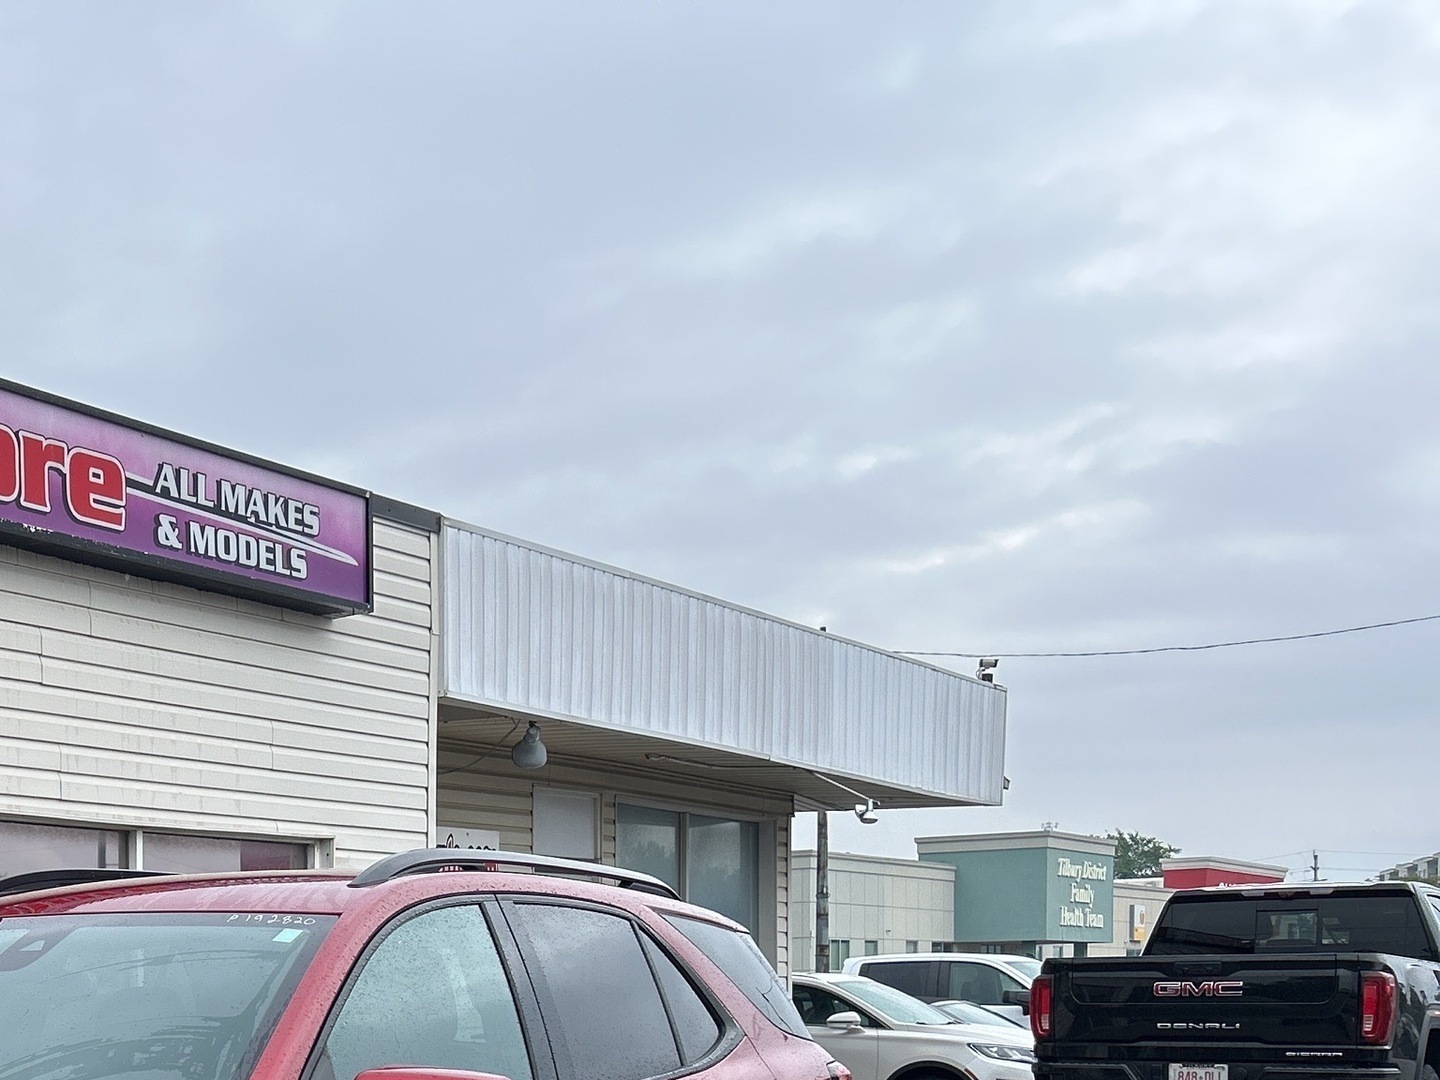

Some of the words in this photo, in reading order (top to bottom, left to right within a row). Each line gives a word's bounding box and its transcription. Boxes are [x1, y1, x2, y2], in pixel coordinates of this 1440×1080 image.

[154, 462, 215, 508] ALL
[219, 479, 320, 537] MAKES
[157, 513, 183, 550] &
[188, 520, 309, 580] MODELS
[1057, 858, 1082, 882] Tilbury
[1081, 861, 1107, 880] District
[1070, 883, 1095, 908] Family
[1059, 906, 1084, 927] Health
[1084, 908, 1104, 928] Team
[1152, 981, 1244, 997] GMC
[1156, 1022, 1241, 1030] DENALI
